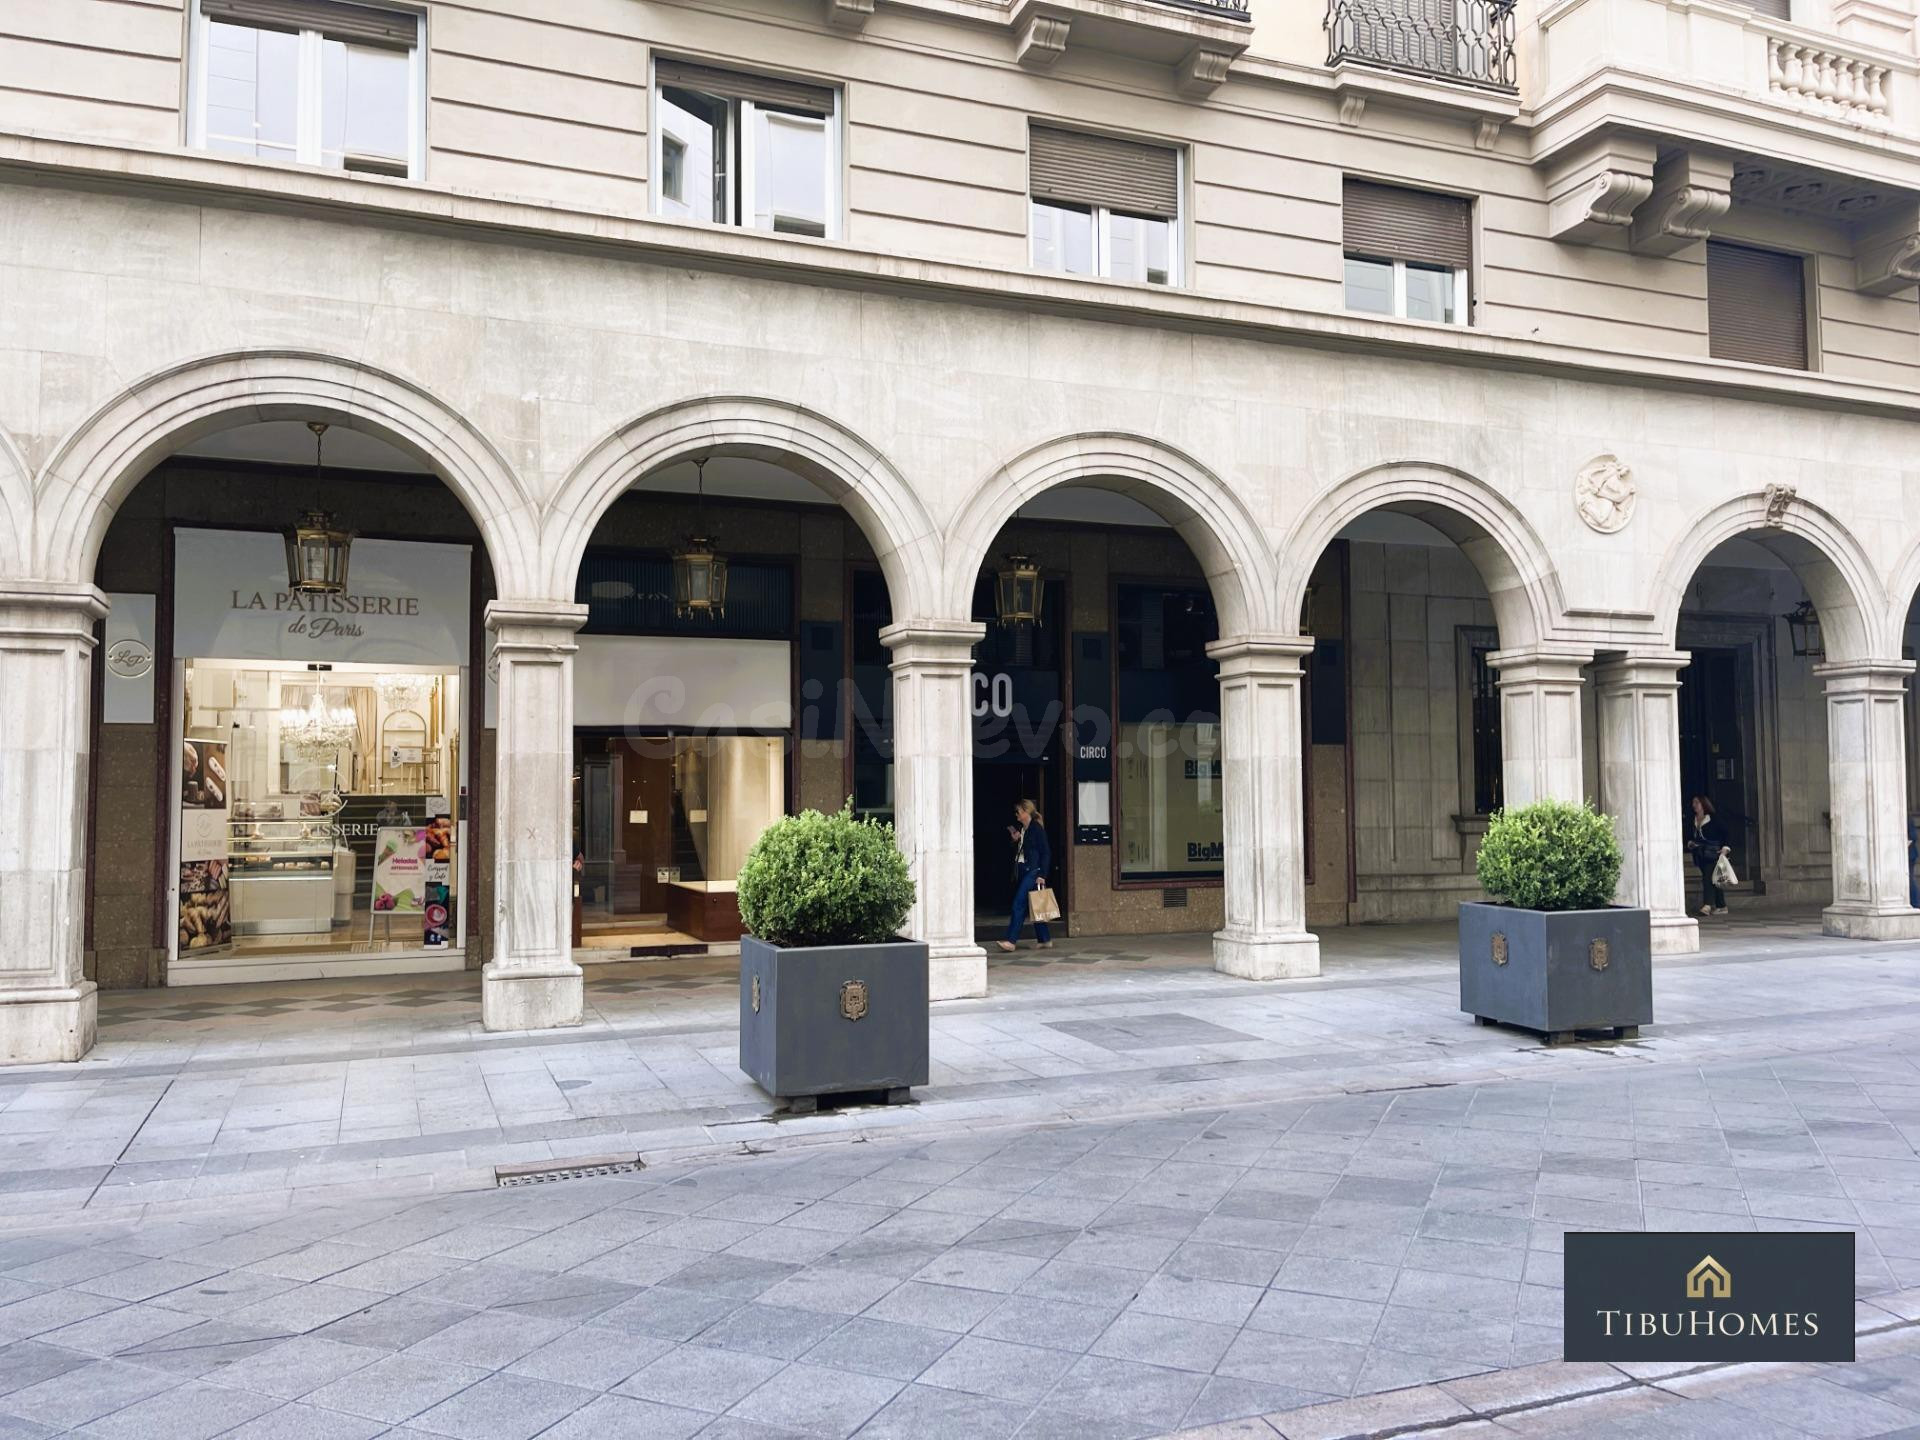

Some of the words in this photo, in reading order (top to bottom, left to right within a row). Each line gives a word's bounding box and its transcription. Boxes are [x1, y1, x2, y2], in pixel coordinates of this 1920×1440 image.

[231, 590, 267, 610] LA
[288, 615, 307, 634] de
[308, 617, 364, 639] Paris
[1080, 746, 1107, 759] CIRCO
